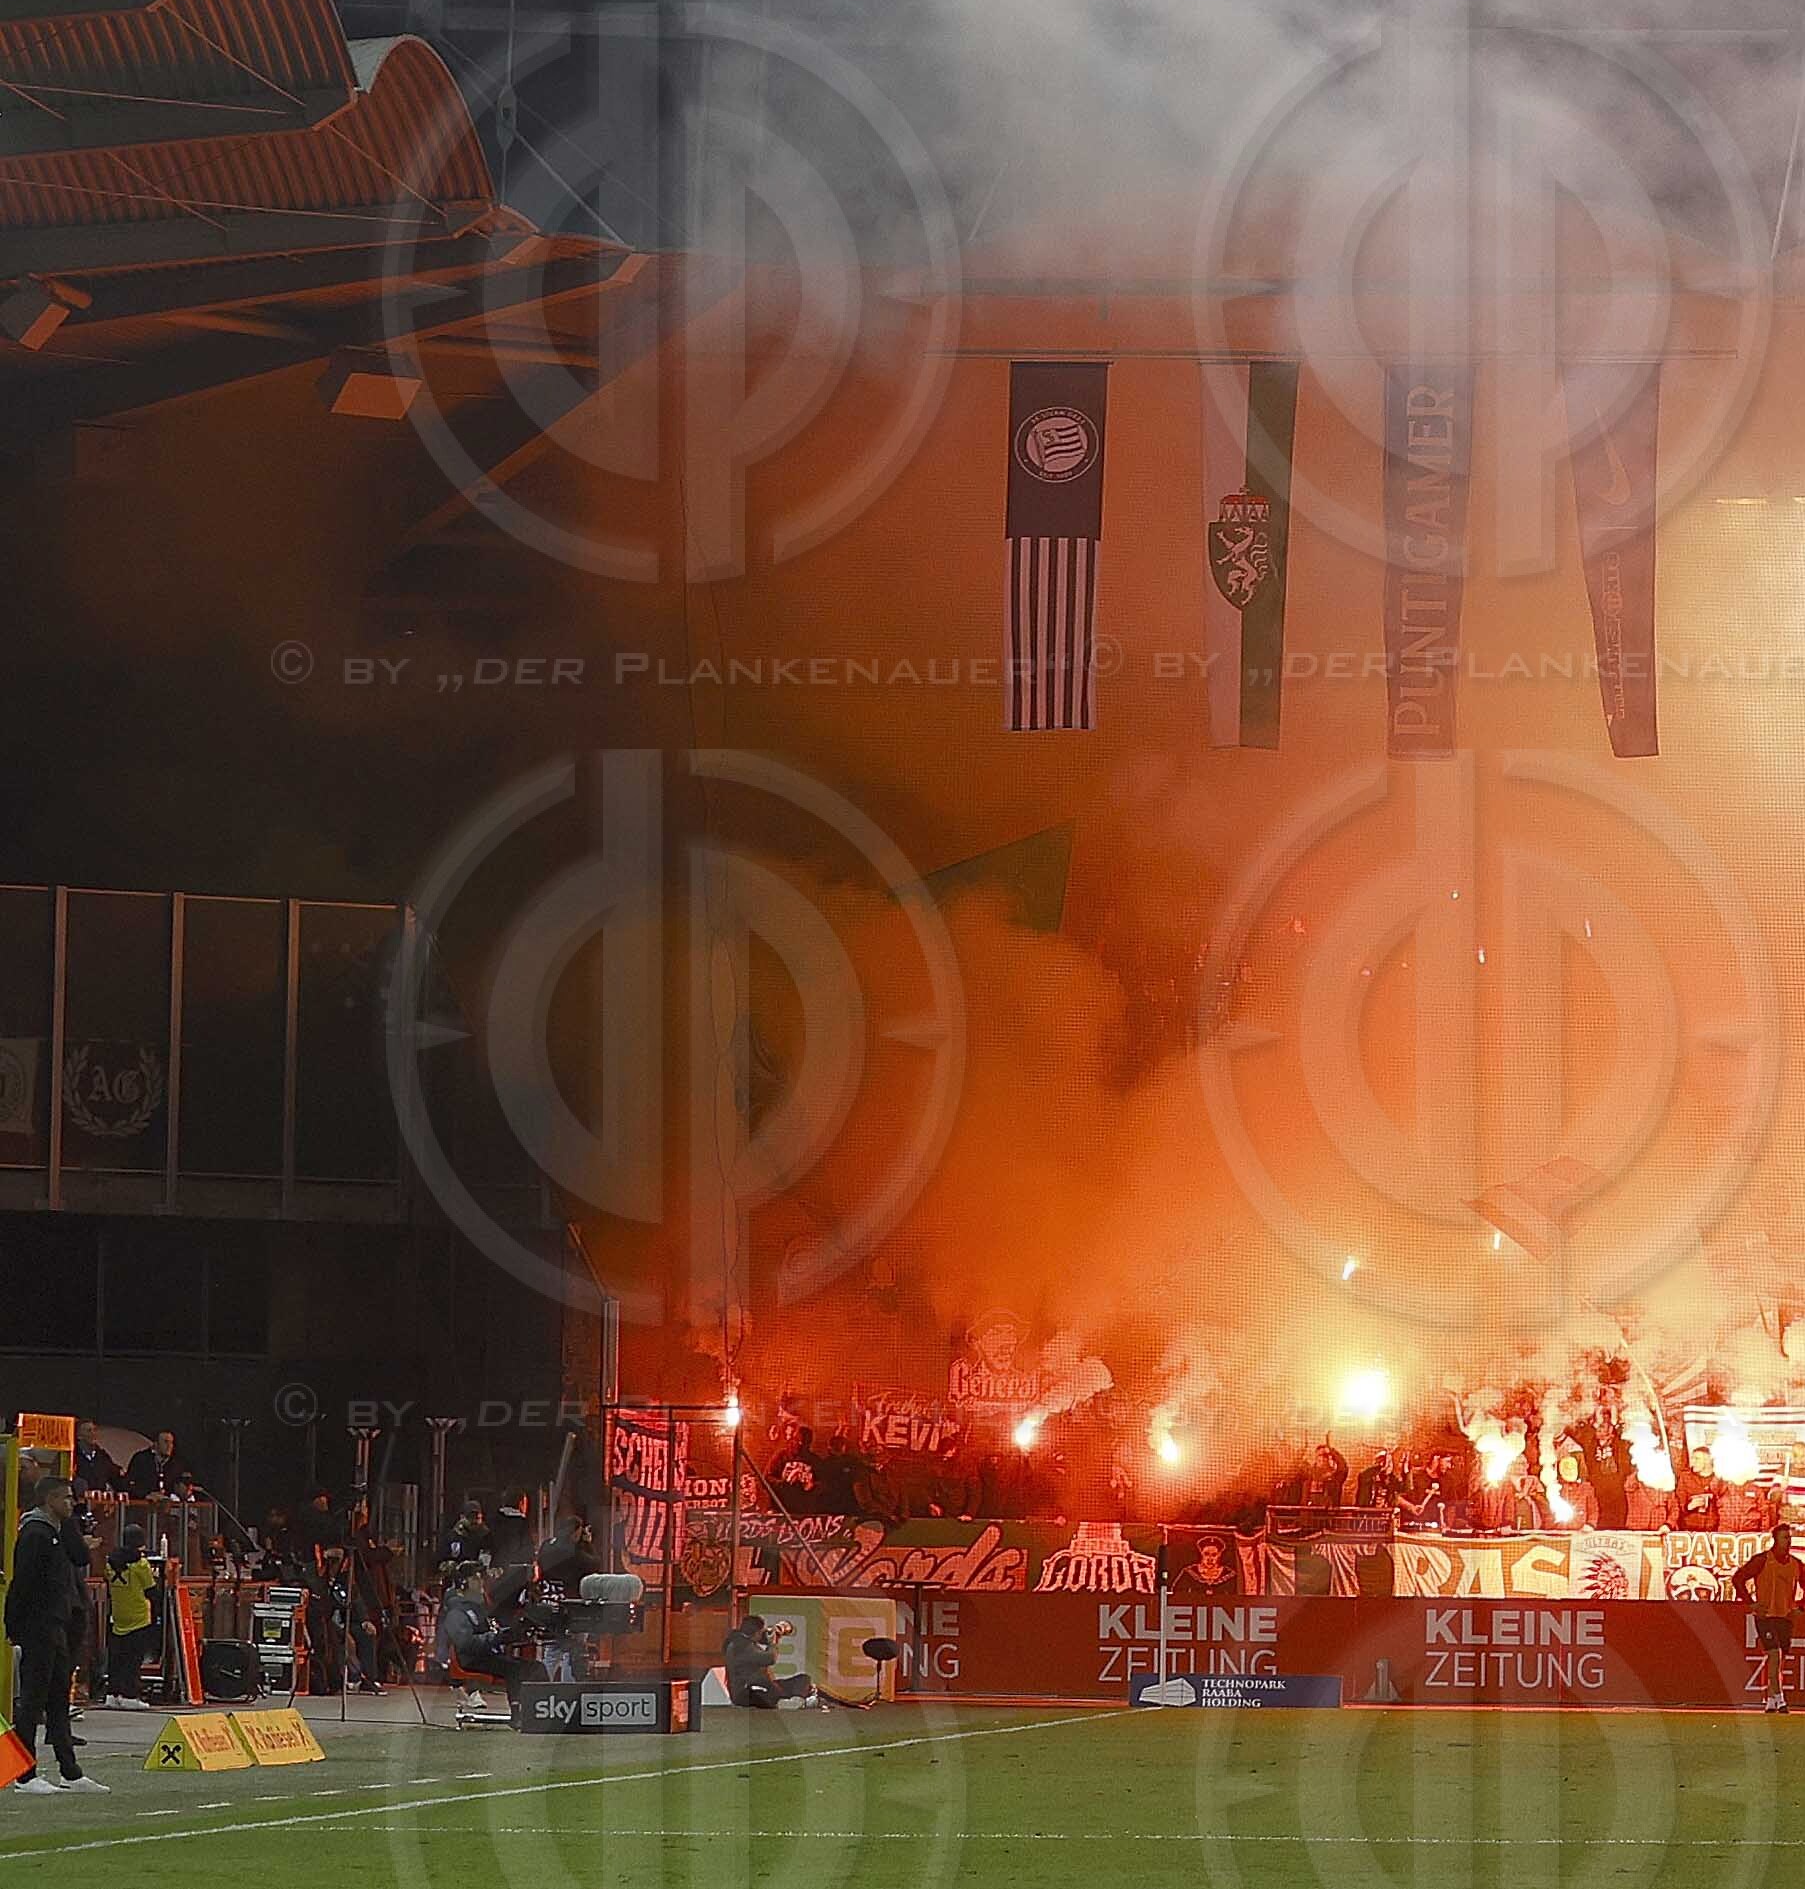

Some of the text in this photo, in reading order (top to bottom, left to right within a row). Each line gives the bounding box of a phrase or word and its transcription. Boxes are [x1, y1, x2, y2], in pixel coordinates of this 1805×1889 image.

[1394, 383, 1455, 736] PUNTIGAMER
[1098, 1604, 1278, 1642] KLEINE
[1425, 1609, 1605, 1645] KLEINE
[1098, 1646, 1277, 1681] ZEITUNG
[1424, 1651, 1605, 1689] ZEITUNG
[1201, 1678, 1286, 1690] TECHNOPARK
[1201, 1688, 1242, 1698] RAABA
[535, 1695, 651, 1724] sky sport
[1201, 1698, 1262, 1708] HOLDING
